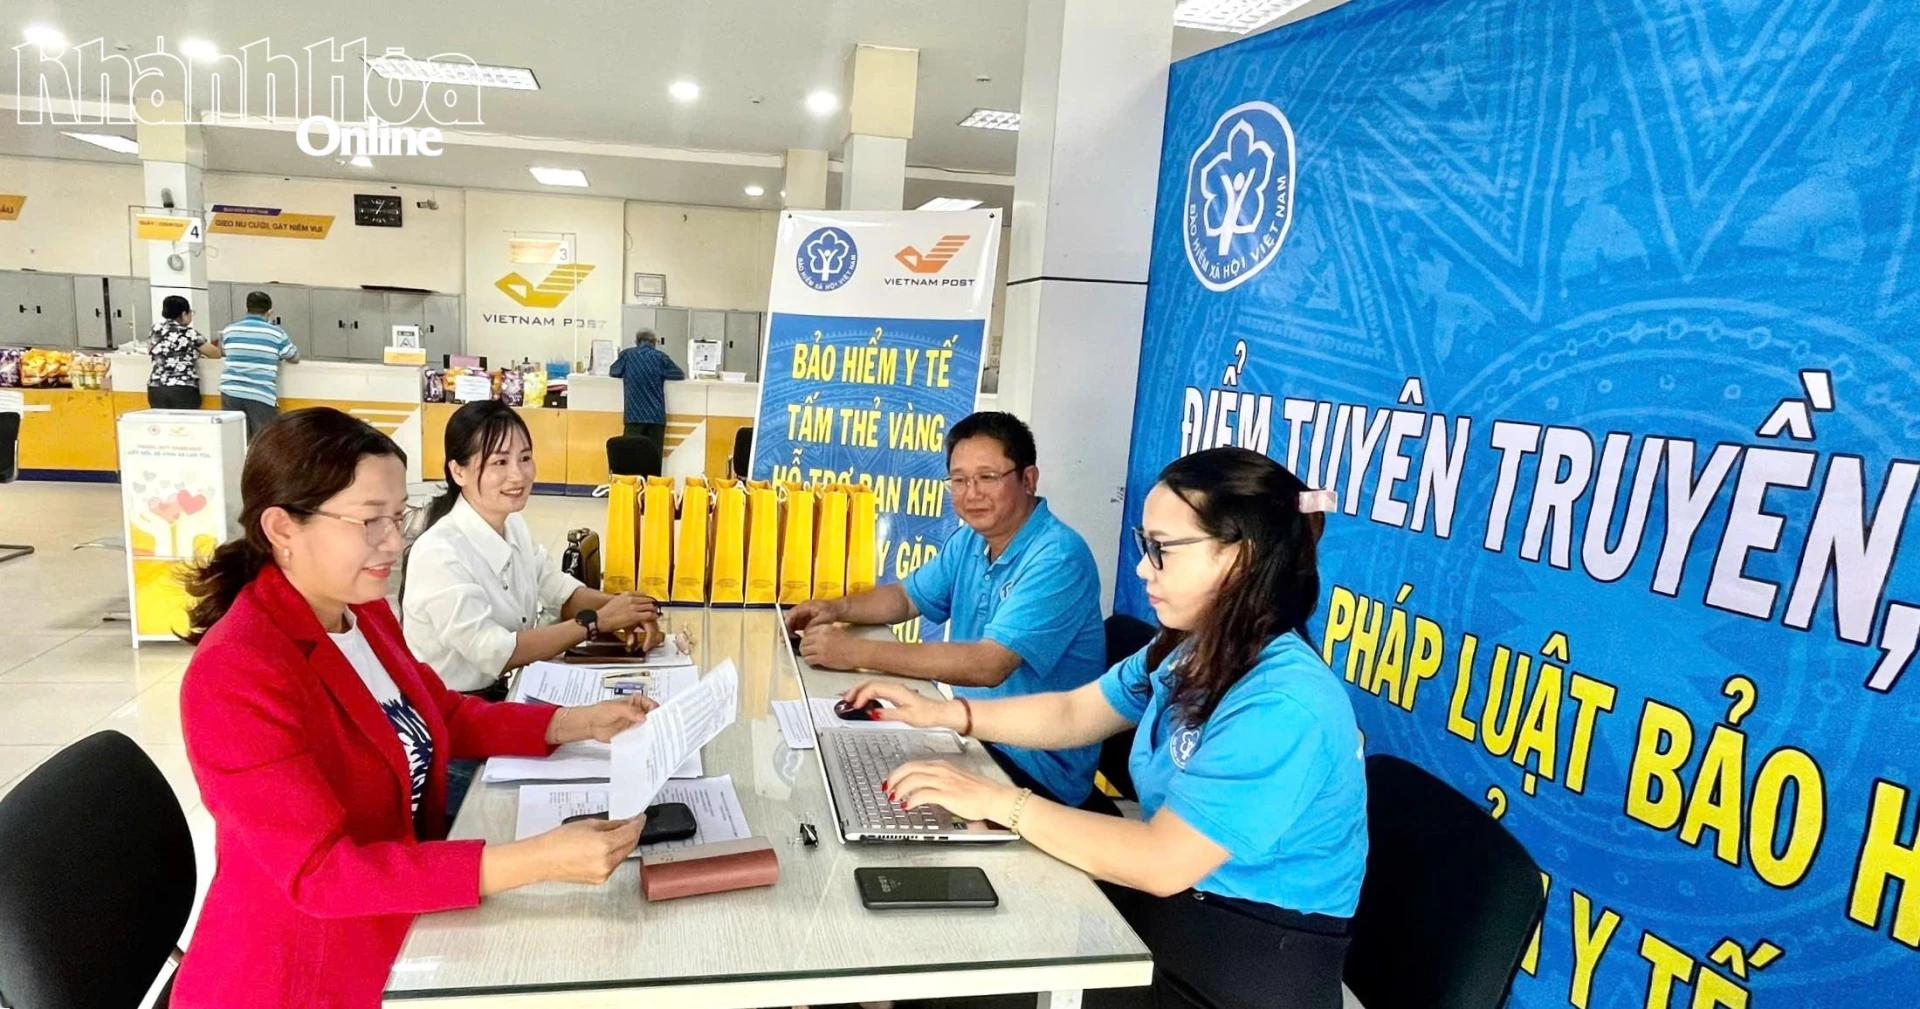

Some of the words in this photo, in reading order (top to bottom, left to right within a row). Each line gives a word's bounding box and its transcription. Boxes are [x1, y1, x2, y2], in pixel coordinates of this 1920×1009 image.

[1276, 174, 1288, 219] NAM
[190, 225, 200, 239] 4
[559, 248, 568, 261] 3
[884, 277, 938, 287] VIETNAM
[941, 278, 976, 287] POST
[482, 313, 556, 326] VIETNAM
[791, 330, 837, 383] BẢO
[841, 327, 898, 386] HIỂM
[904, 348, 920, 387] Y
[925, 334, 959, 388] TẾ
[787, 392, 834, 445] TẤM
[840, 396, 882, 448] THẺ
[888, 402, 946, 454] VÀNG
[906, 477, 946, 518] KHI
[1180, 338, 1274, 458] ĐIỂM
[1283, 376, 1473, 540] TUYÊN
[1482, 368, 1920, 693] TRUYỀN,
[1321, 582, 1445, 713] PHÁP
[1446, 630, 1618, 798] LUẬT
[1623, 673, 1827, 891] BẢO
[1568, 887, 1623, 1009] Y
